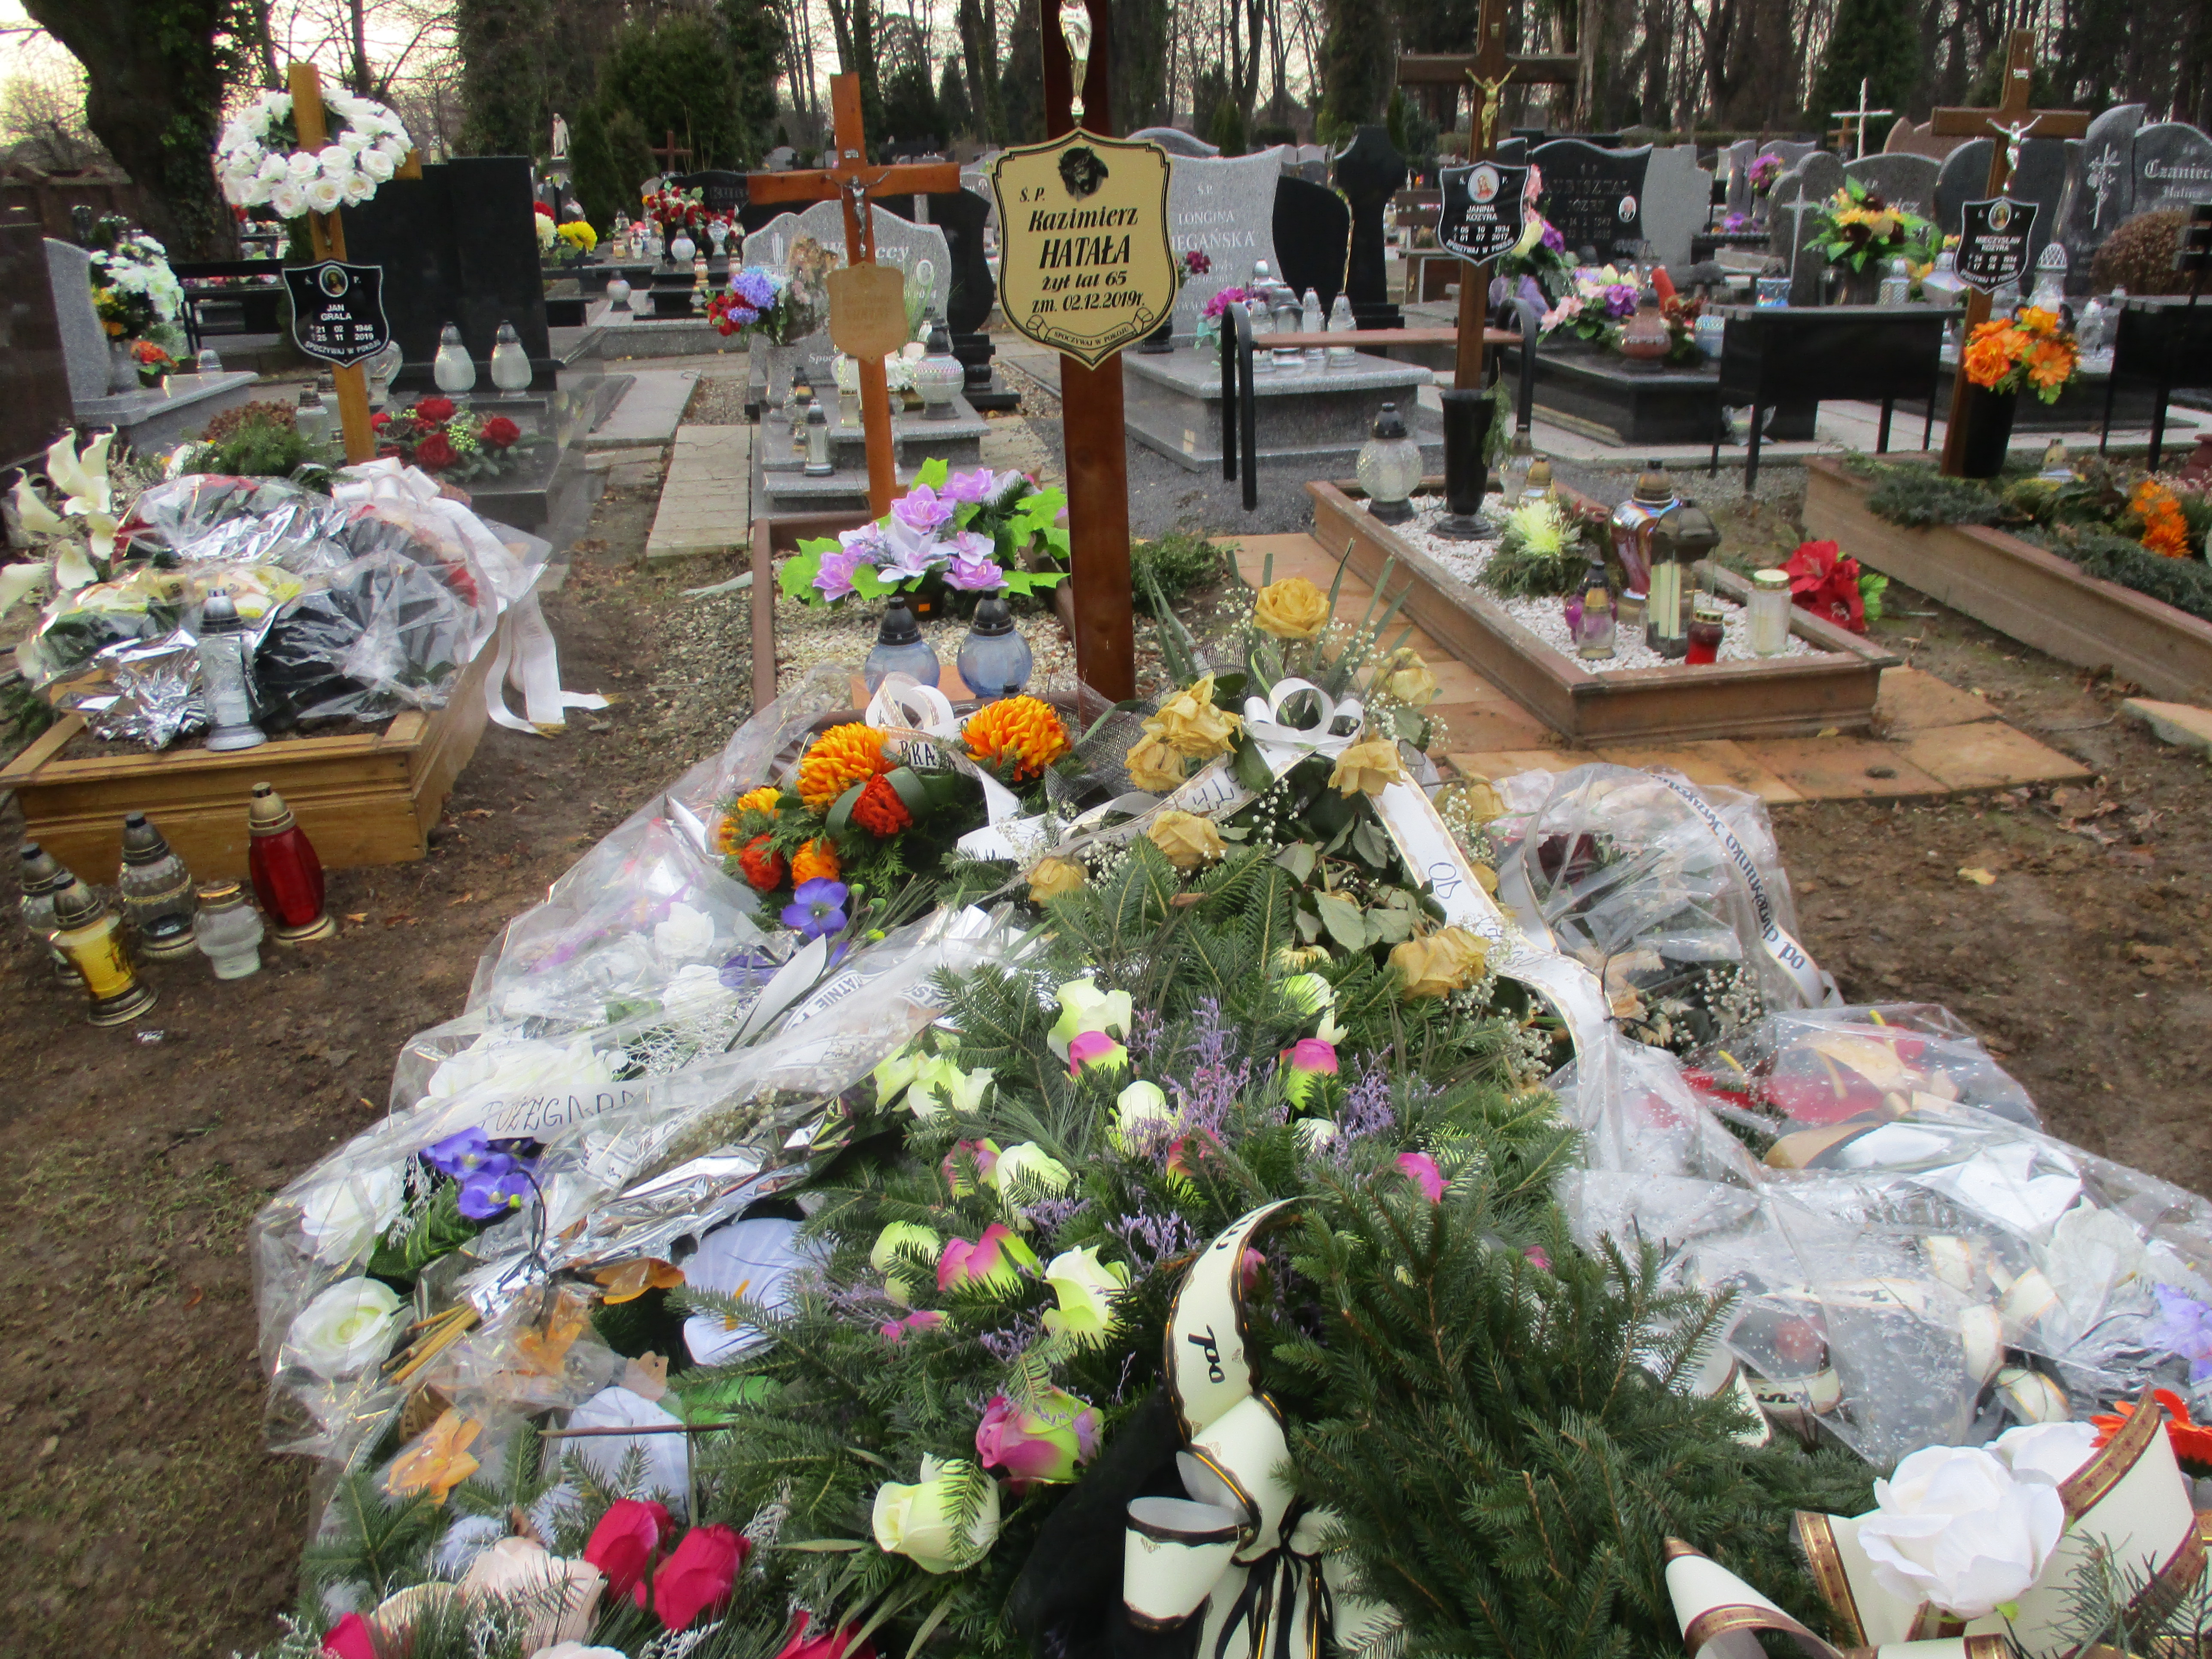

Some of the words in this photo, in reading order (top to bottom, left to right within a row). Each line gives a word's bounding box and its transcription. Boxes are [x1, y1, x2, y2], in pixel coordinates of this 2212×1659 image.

[1034, 187, 1045, 201] P.
[1467, 204, 1495, 213] JANINA
[1028, 206, 1138, 232] Kazimierz
[1178, 210, 1235, 226] LONGINA
[1466, 213, 1498, 222] KOZYRA
[1478, 225, 1486, 234] 10
[1495, 225, 1510, 233] 1934
[1492, 233, 1509, 241] 2017
[1171, 228, 1255, 251] IEGAŃSKA
[1039, 234, 1130, 268] HATAŁA
[1042, 273, 1070, 292] żył
[1075, 272, 1100, 288] lat
[1105, 270, 1127, 286] 65
[326, 304, 344, 312] JAN
[1032, 299, 1057, 313] zm.
[1063, 290, 1145, 311] 02.12.2019r.
[321, 312, 352, 321] GRALA
[1054, 331, 1093, 346] SPOCZYWAJ
[1104, 326, 1130, 342] POKOJU
[1188, 1324, 1225, 1384] od
